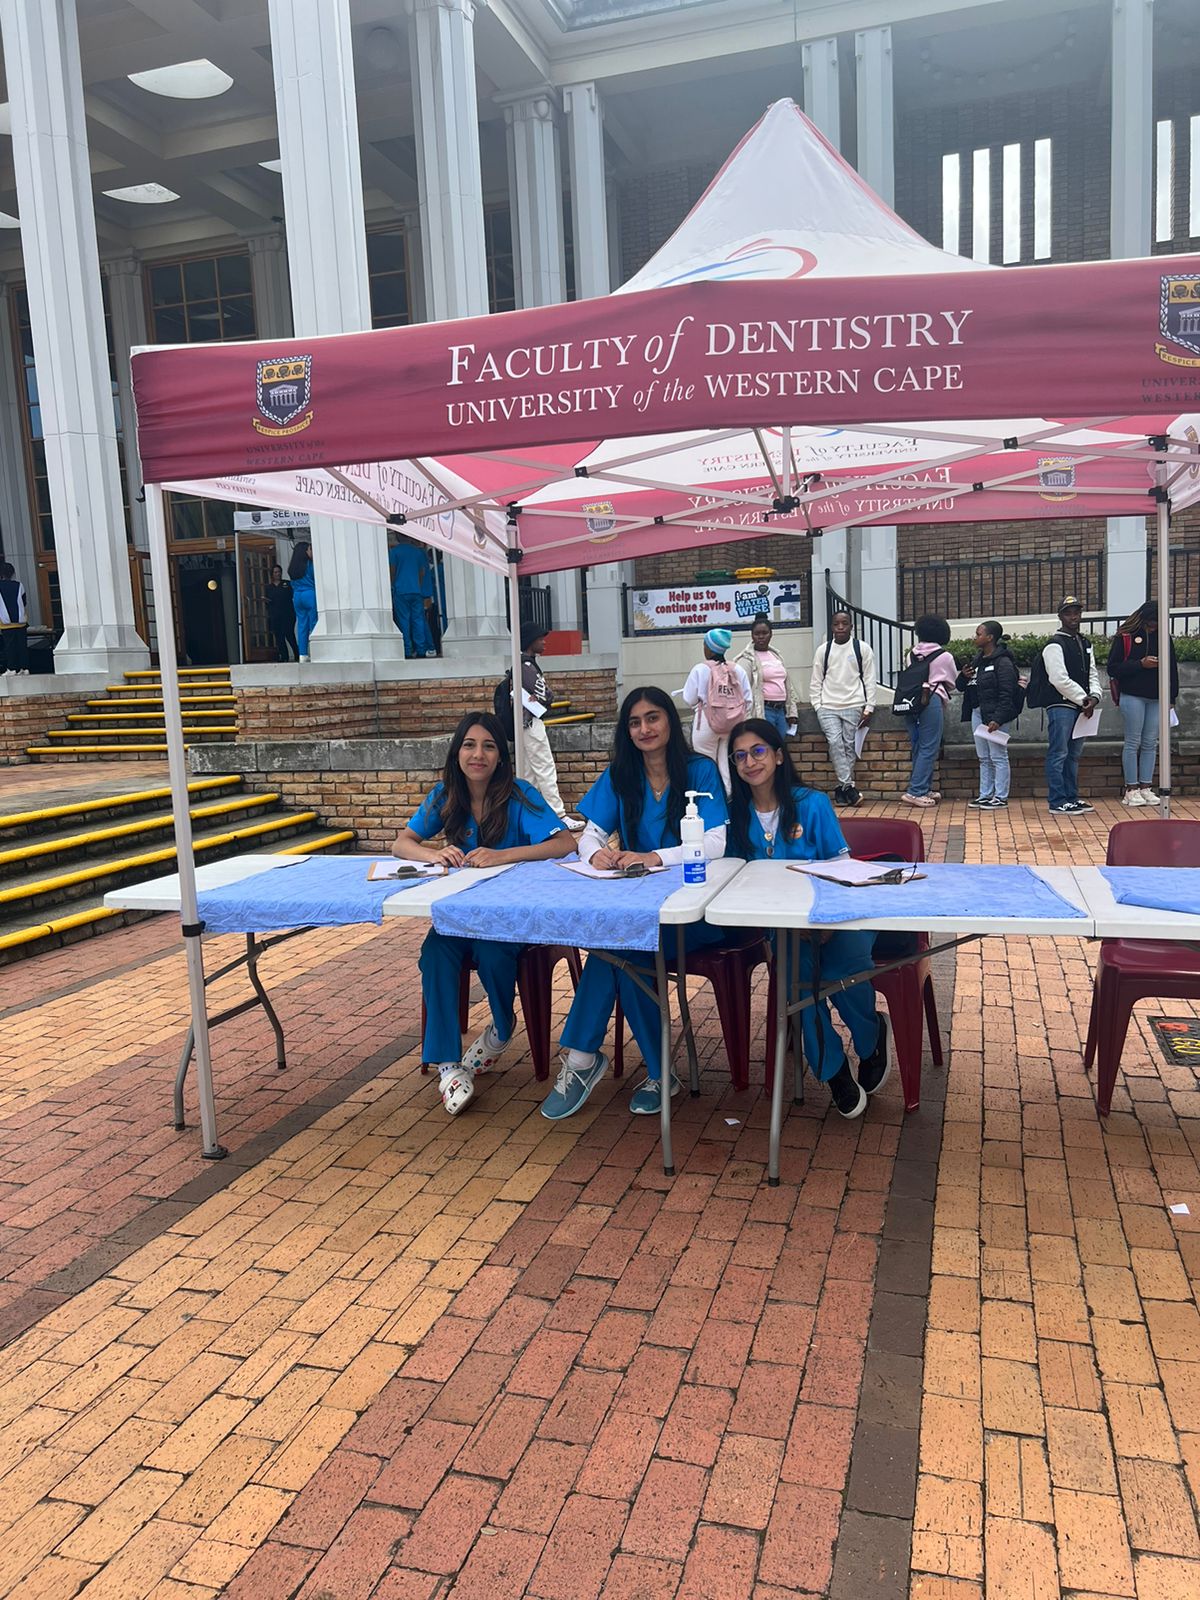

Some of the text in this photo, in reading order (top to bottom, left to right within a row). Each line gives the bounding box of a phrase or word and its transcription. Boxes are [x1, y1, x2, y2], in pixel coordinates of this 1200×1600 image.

[446, 309, 974, 387] FACULTY of DENTISTRY
[1162, 352, 1198, 366] RESPICE
[1142, 376, 1200, 388] UNIVER
[446, 364, 965, 427] UNIVERSITY of the WESTERN CAPE
[272, 510, 290, 518] SEE
[271, 519, 294, 527] Change
[668, 589, 717, 603] Help us to
[736, 596, 768, 608] WATER
[655, 603, 698, 614] continue
[698, 599, 731, 613] saving
[737, 603, 769, 617] WISE
[679, 614, 708, 624] water
